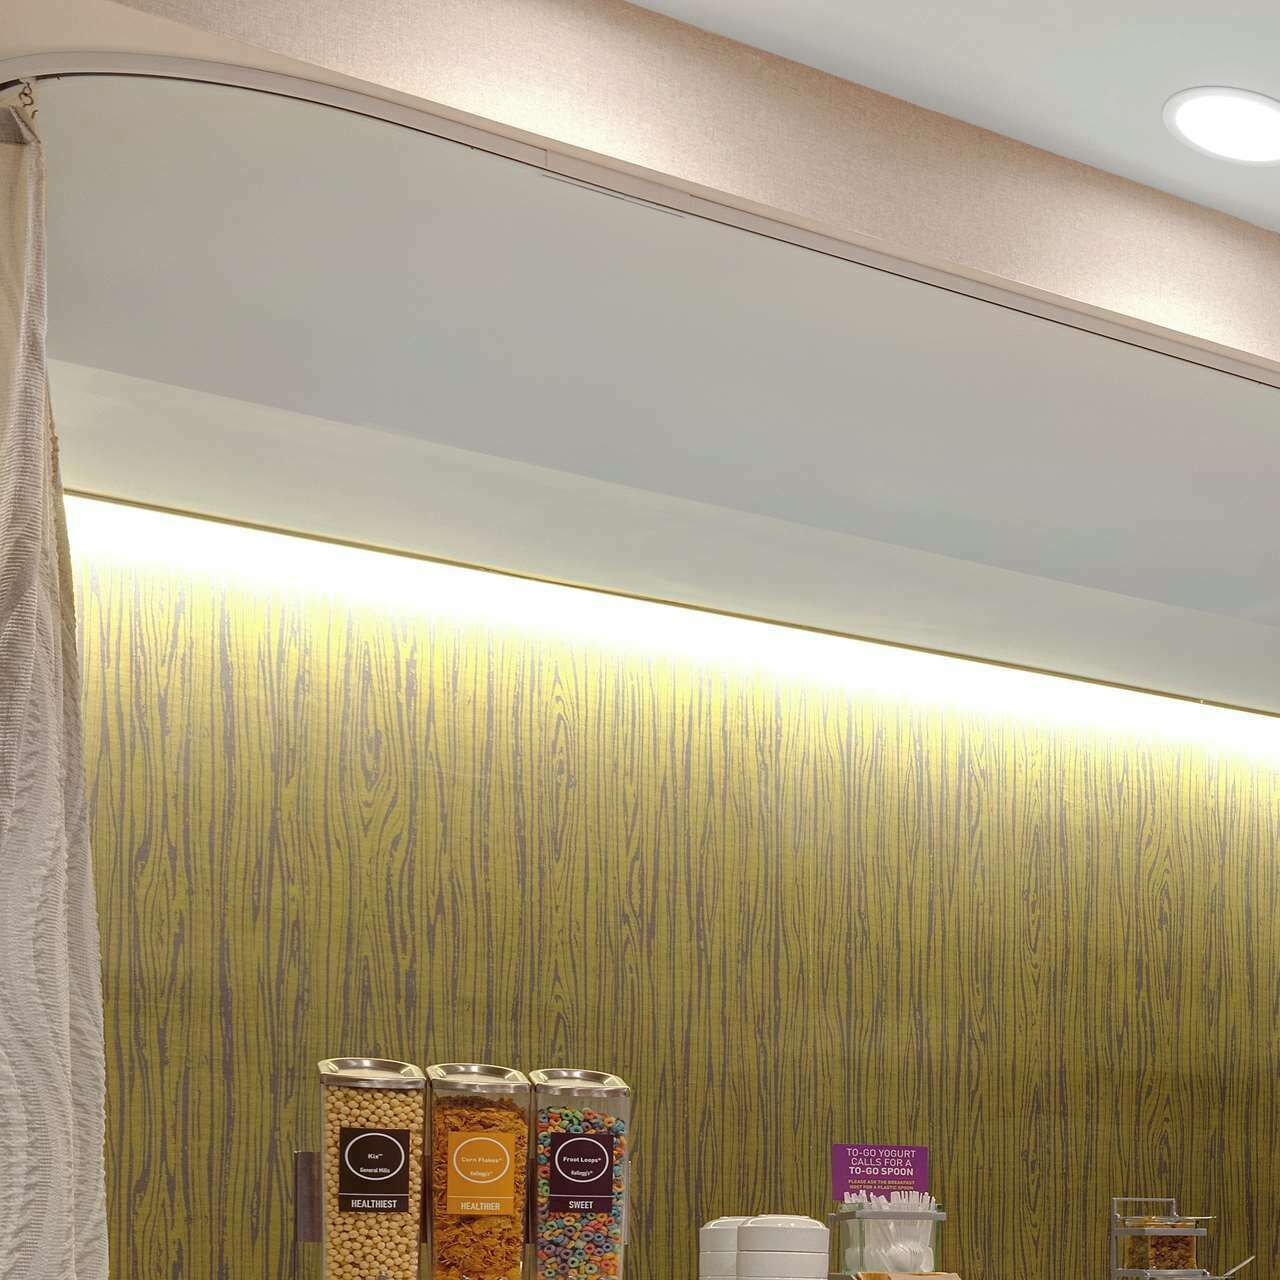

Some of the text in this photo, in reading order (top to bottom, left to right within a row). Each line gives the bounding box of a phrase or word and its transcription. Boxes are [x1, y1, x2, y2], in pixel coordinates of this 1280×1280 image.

[846, 1148, 916, 1158] TO-GO YOGURT
[851, 1158, 881, 1166] CALLS
[884, 1159, 903, 1167] FOR
[849, 1166, 914, 1176] TO-GO SPOON
[351, 1200, 397, 1208] HEALTHIEST
[461, 1202, 500, 1210] HEALTHIER
[569, 1201, 593, 1209] SWEET
